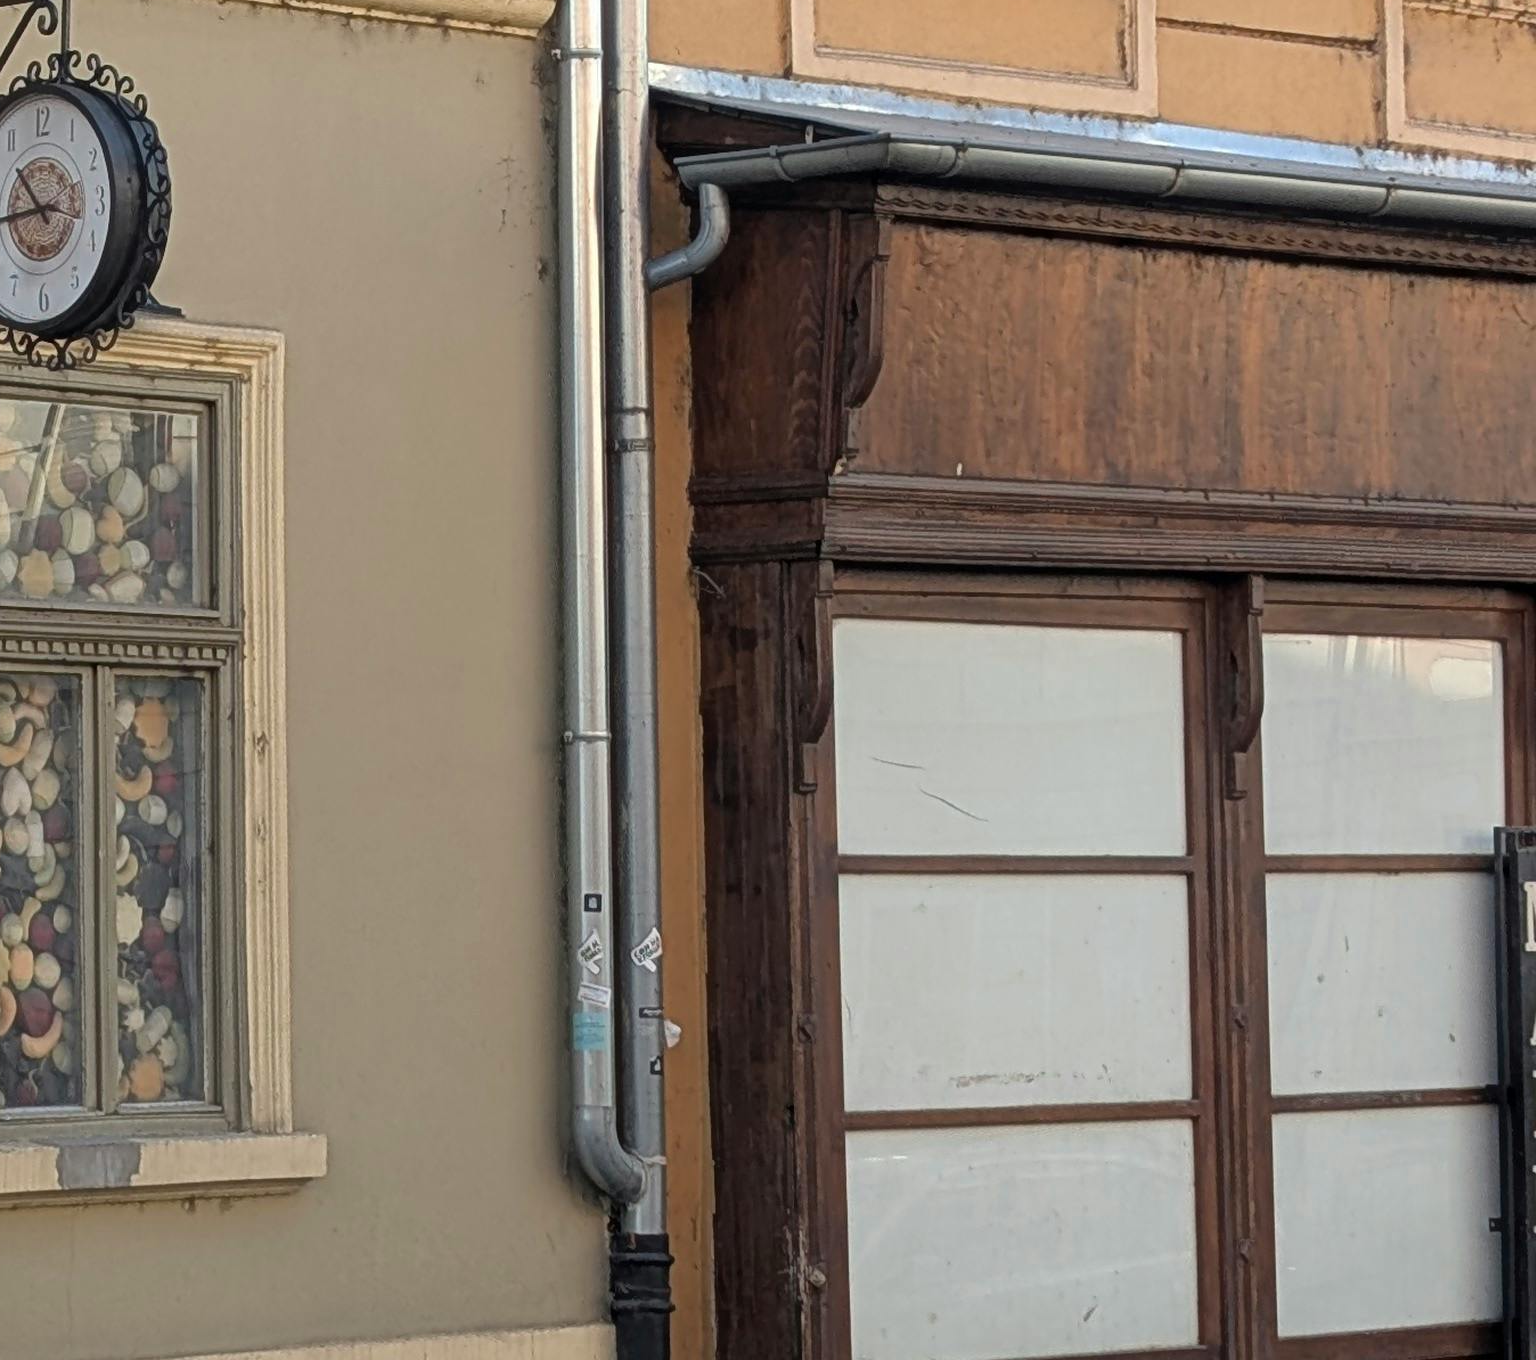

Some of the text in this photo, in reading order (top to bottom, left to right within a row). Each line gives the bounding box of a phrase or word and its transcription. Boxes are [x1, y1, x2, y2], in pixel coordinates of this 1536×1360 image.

[36, 106, 51, 137] 12
[7, 129, 16, 152] 11
[88, 147, 97, 171] 2
[94, 184, 105, 216] 3
[9, 273, 19, 296] 7
[70, 266, 79, 290] 5
[39, 282, 50, 312] 6
